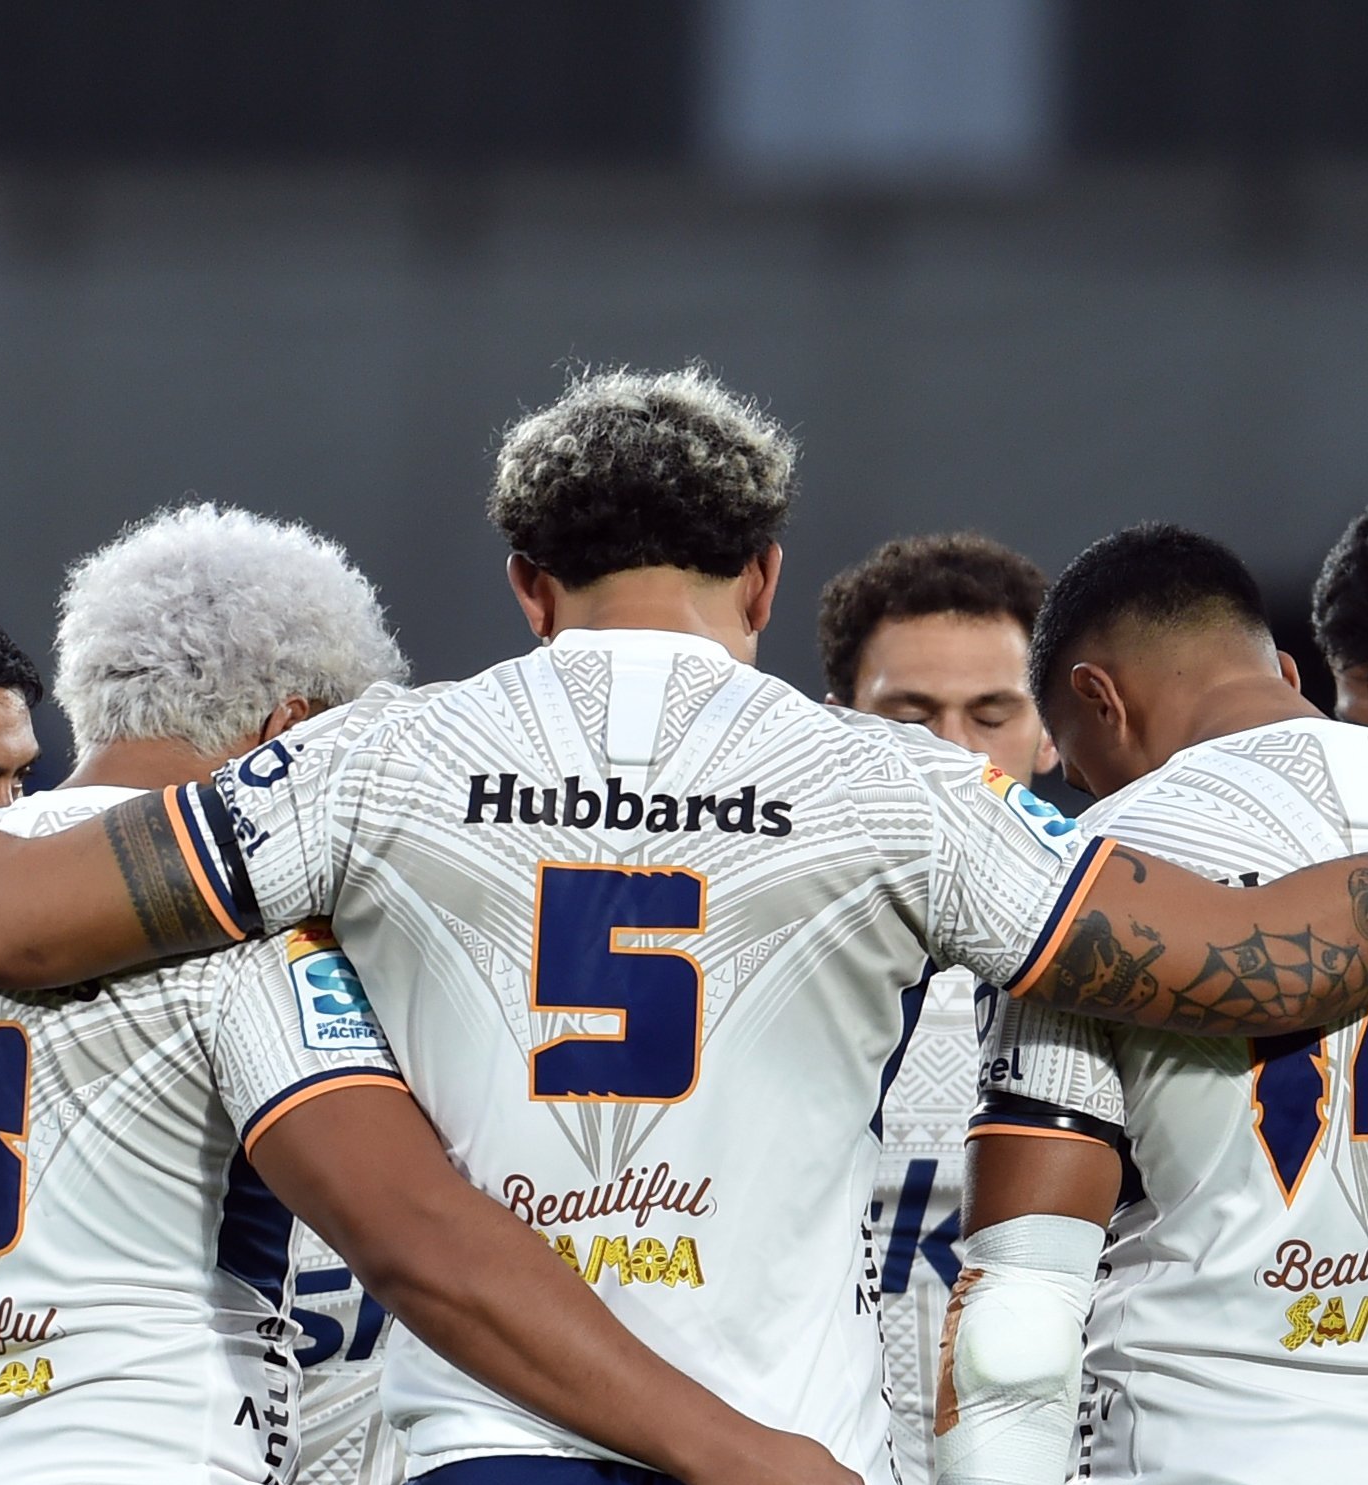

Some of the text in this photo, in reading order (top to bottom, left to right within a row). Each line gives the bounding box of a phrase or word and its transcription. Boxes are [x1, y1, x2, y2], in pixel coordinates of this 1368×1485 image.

[462, 772, 794, 839] Hubbards
[527, 859, 707, 1105] 5
[502, 1161, 713, 1229] Beautiful
[535, 1234, 706, 1289] AMOA
